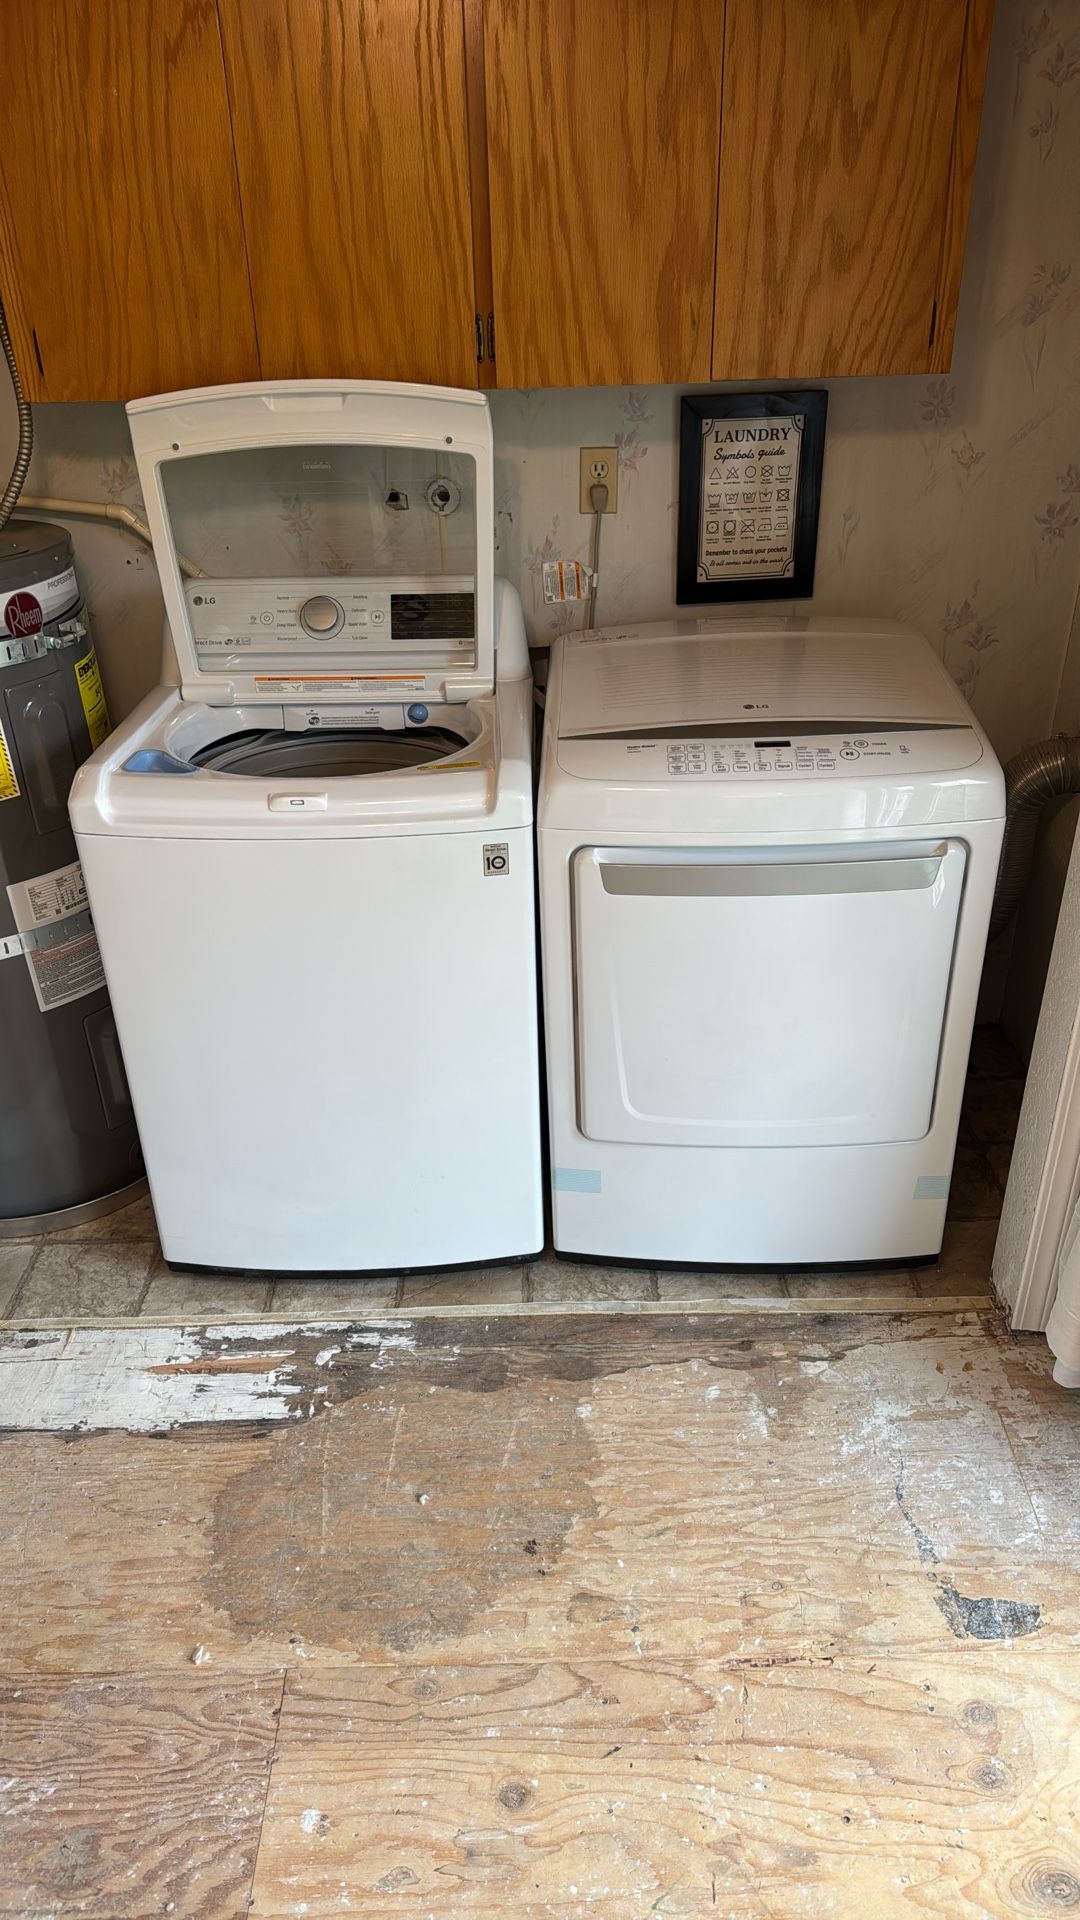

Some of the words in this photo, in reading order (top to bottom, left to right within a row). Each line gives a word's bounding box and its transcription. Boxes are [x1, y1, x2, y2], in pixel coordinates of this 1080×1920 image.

[714, 427, 791, 443] LAUNDRY
[713, 447, 755, 463] Symbols
[757, 445, 786, 461] guide
[705, 549, 731, 557] Remember
[739, 547, 754, 555] check
[755, 548, 767, 556] your
[767, 546, 788, 554] pockets
[204, 597, 216, 605] LG
[8, 595, 42, 636] Rheem
[486, 856, 506, 870] 10
